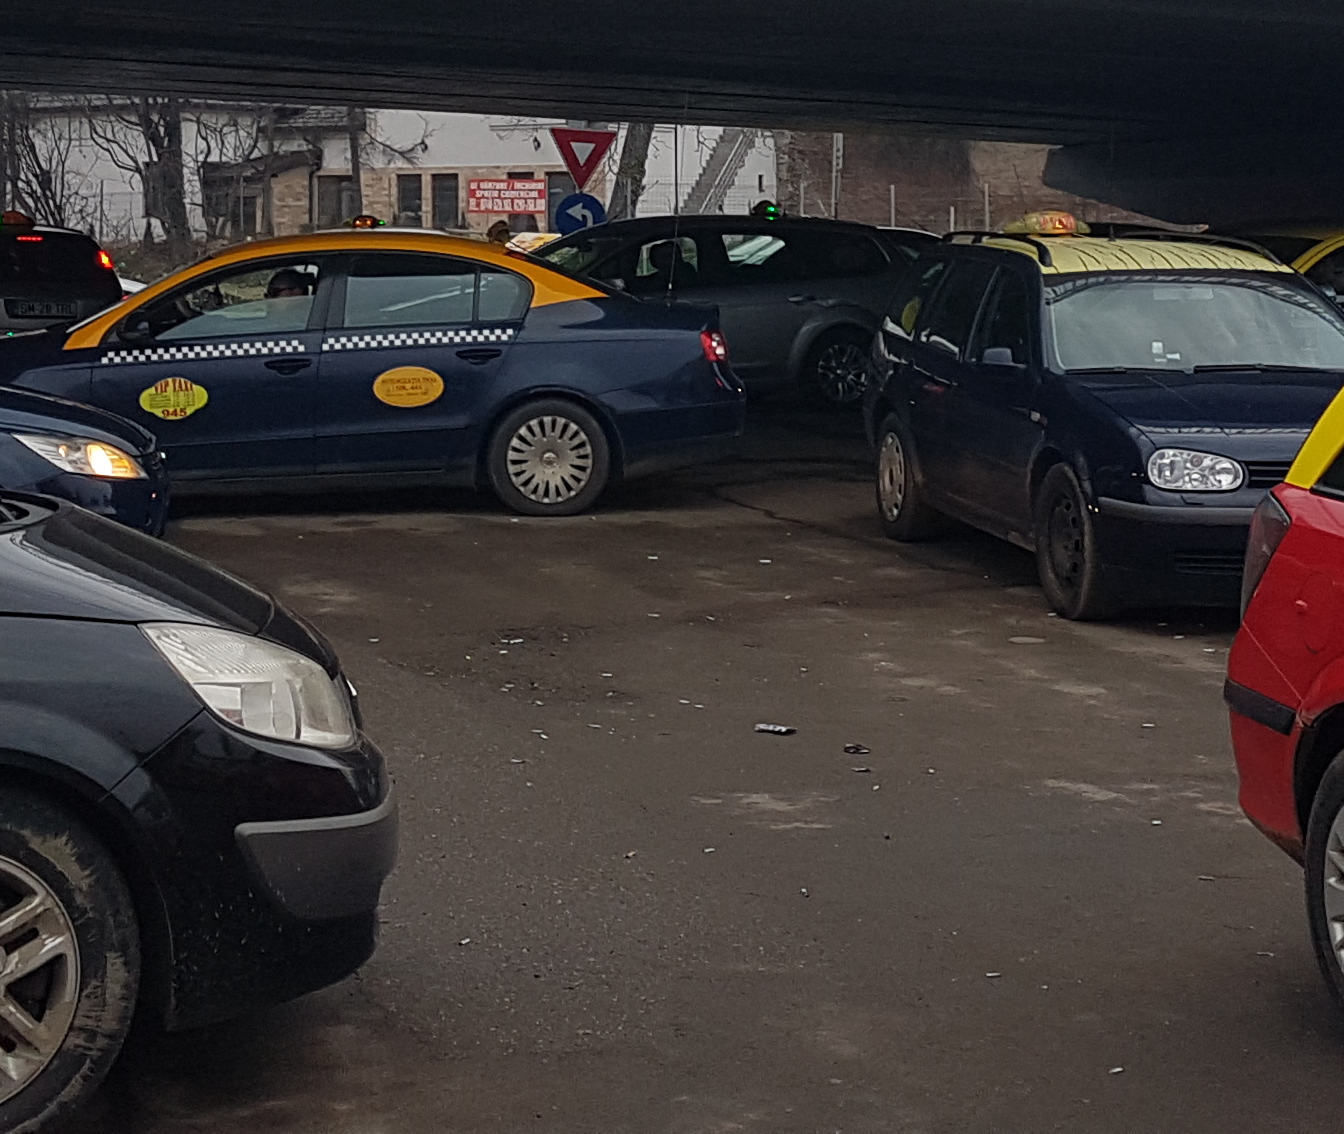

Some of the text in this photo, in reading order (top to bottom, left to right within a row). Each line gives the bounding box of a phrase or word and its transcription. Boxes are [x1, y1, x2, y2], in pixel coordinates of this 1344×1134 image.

[154, 378, 194, 393] VIP TAXI
[162, 408, 187, 418] 945
